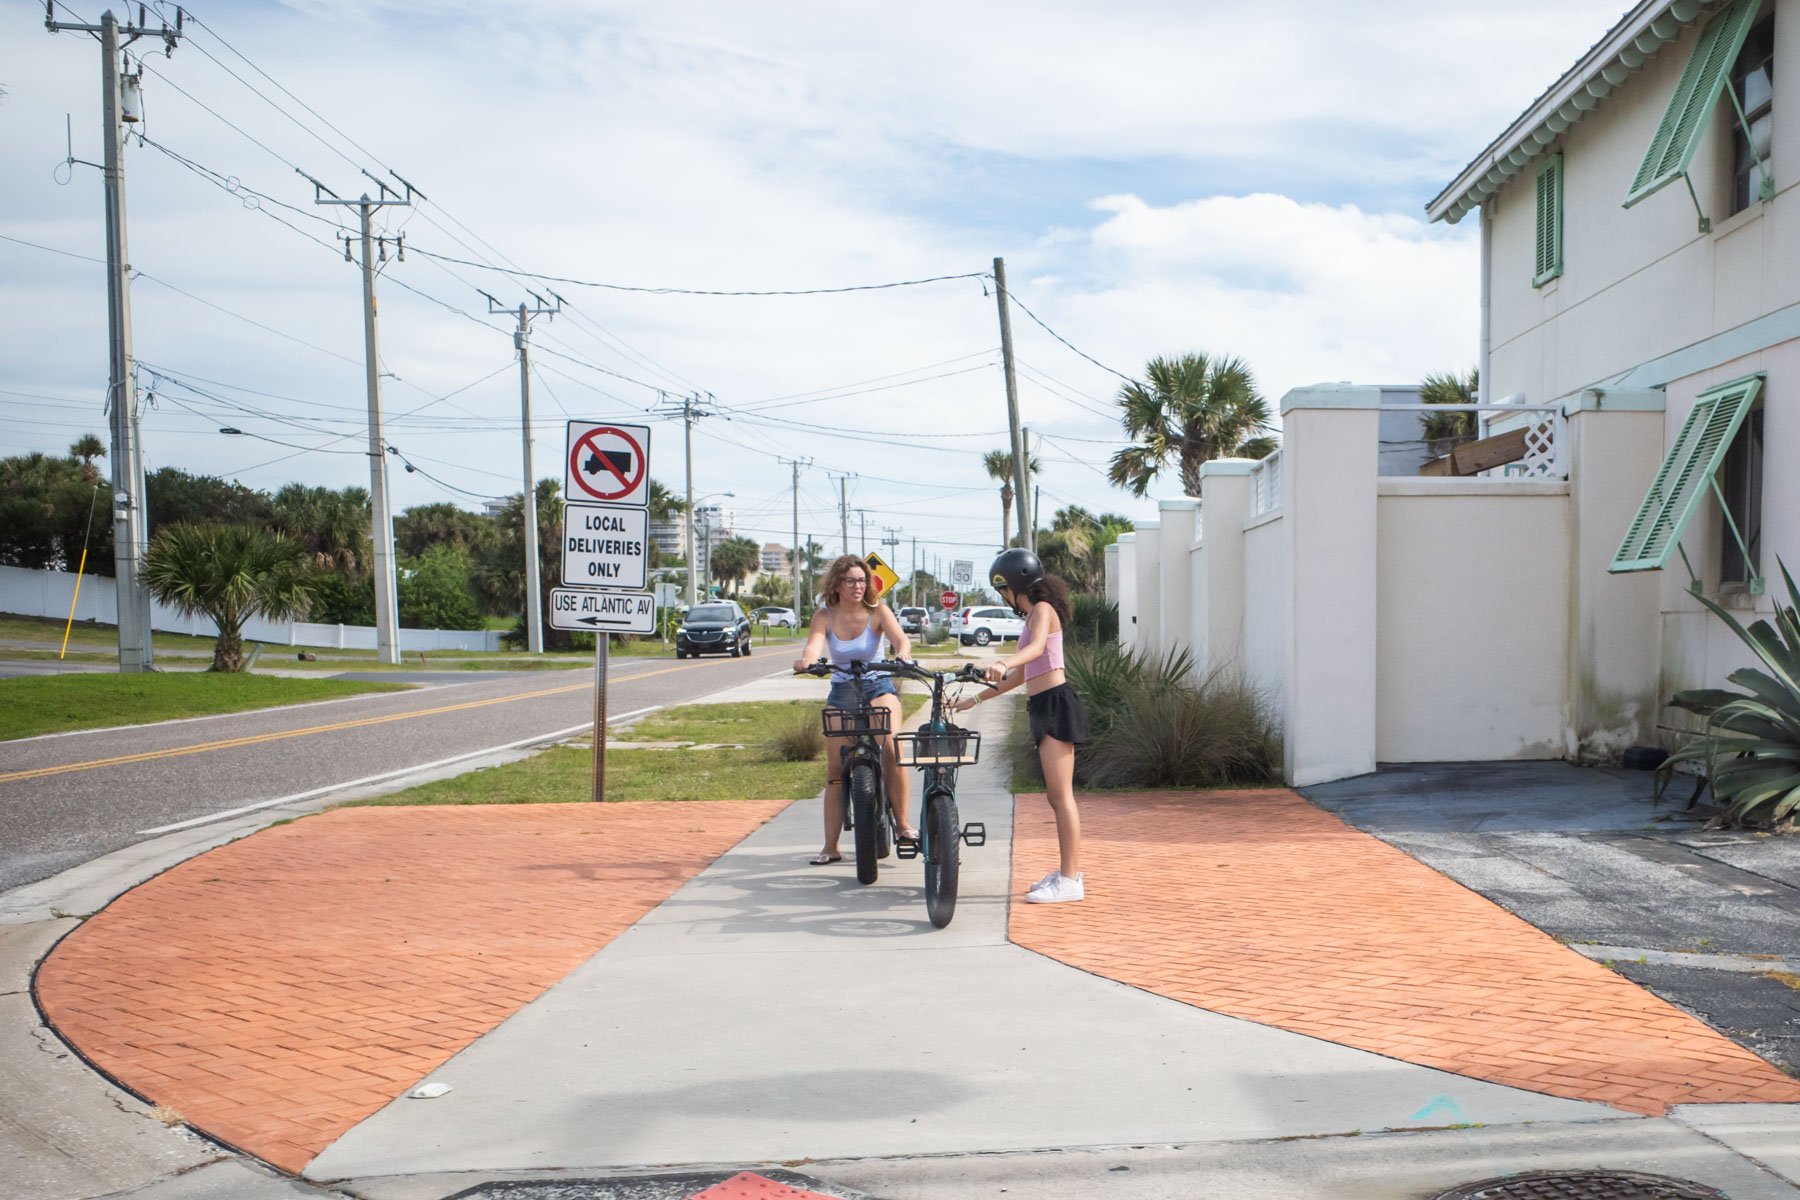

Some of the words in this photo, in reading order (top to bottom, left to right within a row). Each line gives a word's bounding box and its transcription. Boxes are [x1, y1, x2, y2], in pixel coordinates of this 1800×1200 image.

[586, 515, 626, 532] LOCAL
[568, 537, 641, 556] DELIVERIES
[588, 561, 621, 577] ONLY
[955, 573, 970, 582] 30
[555, 595, 577, 612] USE
[582, 596, 632, 614] ATLANTIC
[637, 599, 650, 615] AV
[941, 596, 957, 604] STOP
